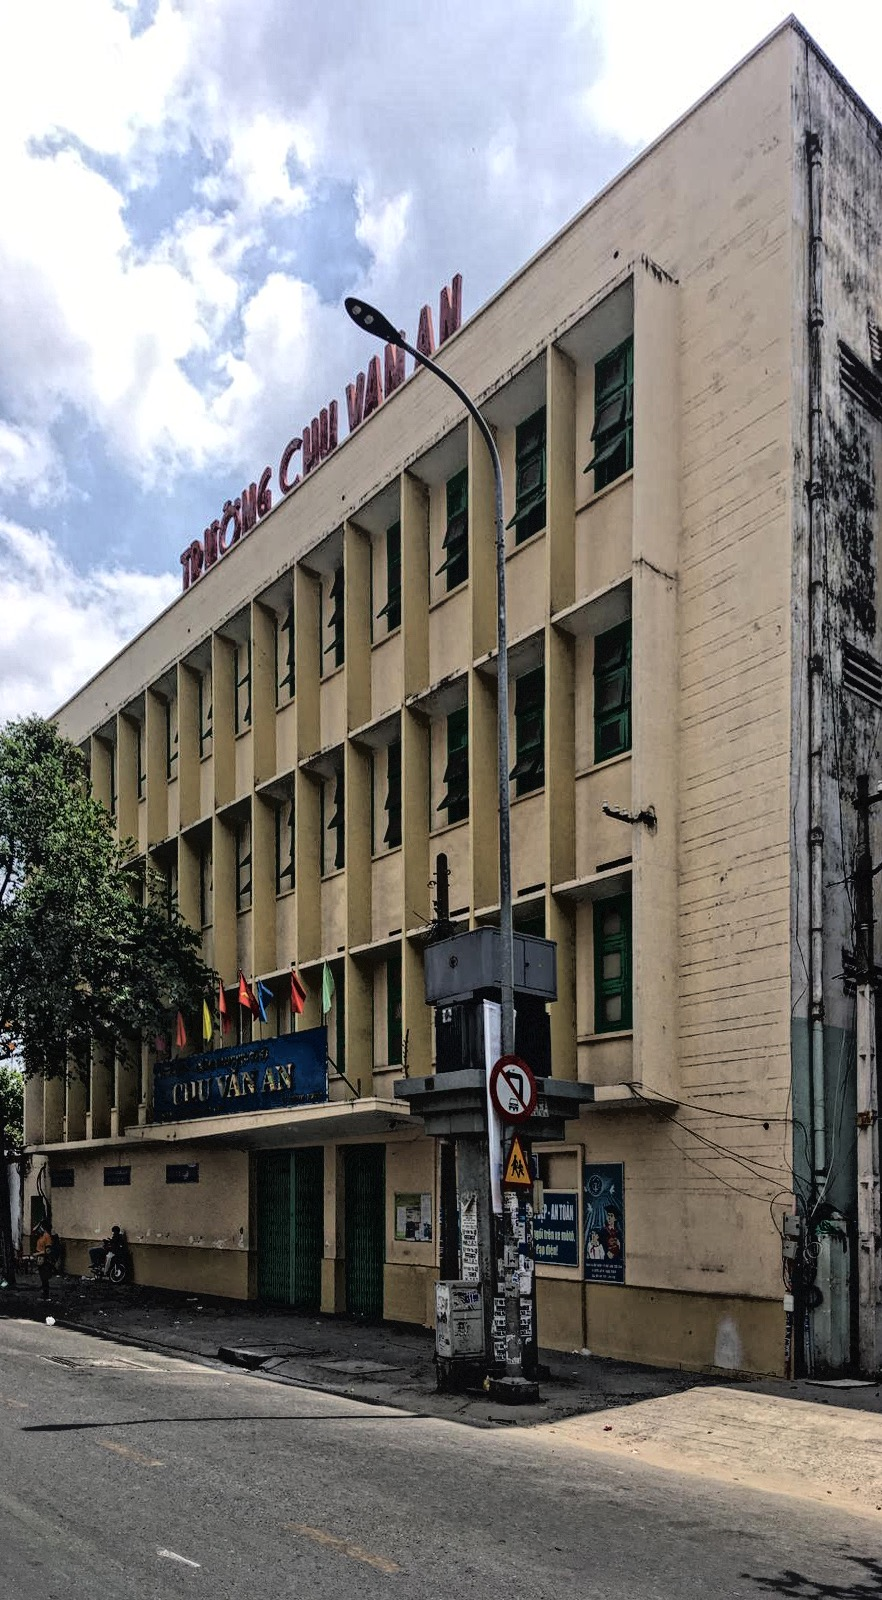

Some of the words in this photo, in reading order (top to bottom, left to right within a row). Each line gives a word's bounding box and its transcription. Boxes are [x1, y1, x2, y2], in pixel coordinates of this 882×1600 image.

[279, 399, 339, 496] CHU
[414, 272, 463, 372] AN
[173, 1077, 211, 1106] CHU
[261, 1062, 295, 1093] AN
[551, 1204, 558, 1220] AN
[559, 1201, 573, 1221] TOÀN
